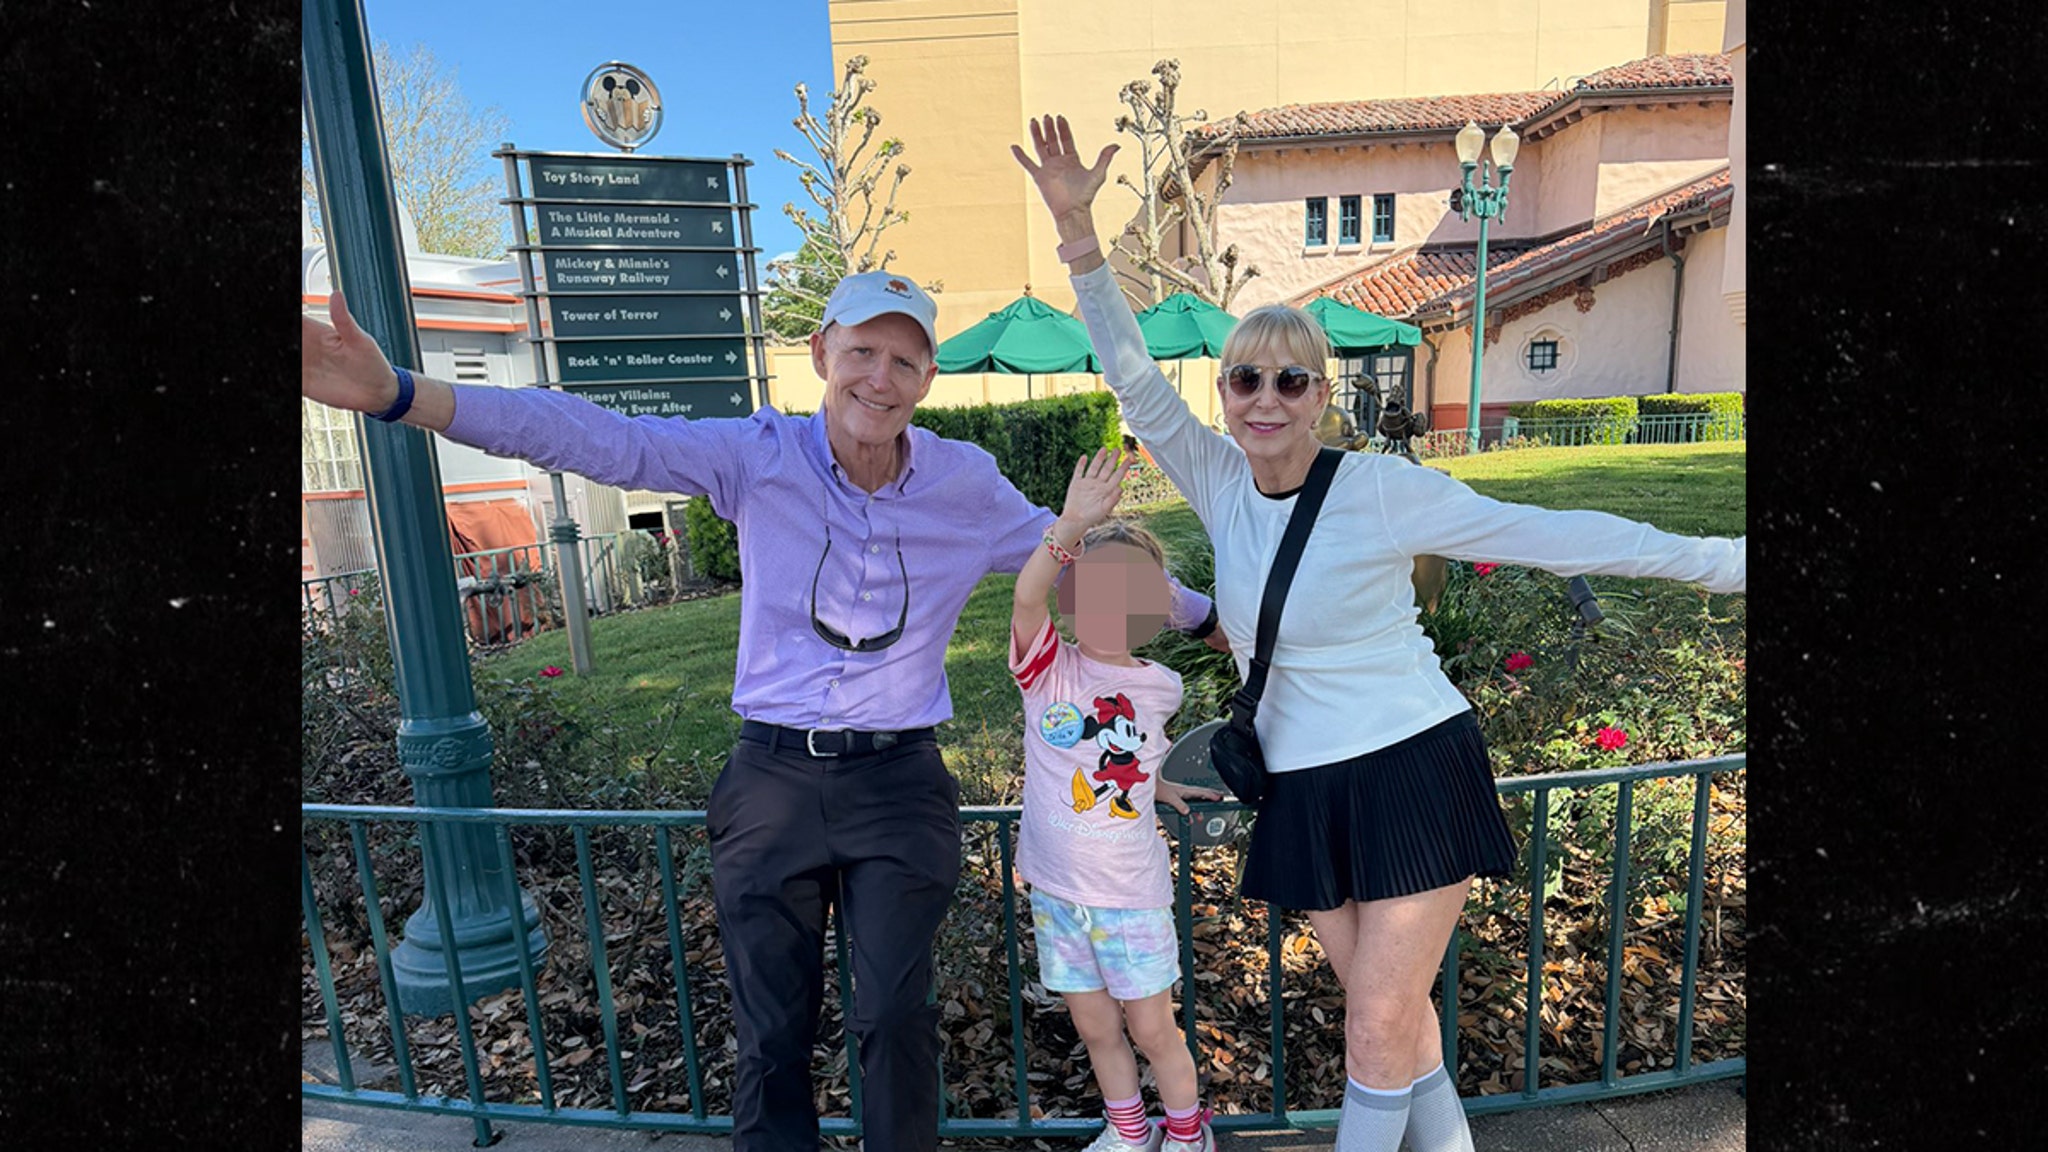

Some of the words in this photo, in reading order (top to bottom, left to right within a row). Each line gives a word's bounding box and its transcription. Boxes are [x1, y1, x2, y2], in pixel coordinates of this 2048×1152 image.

[543, 171, 566, 185] Toy
[570, 172, 604, 187] Story
[608, 173, 640, 185] Land
[548, 211, 573, 223] The
[576, 212, 611, 223] Little
[614, 213, 670, 224] Mermaid
[551, 227, 561, 237] A
[564, 226, 613, 238] Musical
[616, 227, 680, 239] Adventure
[555, 258, 600, 271] Mickey
[604, 258, 615, 269] &
[618, 258, 670, 269] Minnie's
[557, 273, 616, 286] Runaway
[619, 272, 670, 286] Railway
[561, 310, 600, 321] Tower
[603, 309, 617, 320] of
[620, 310, 659, 320] Terror
[568, 356, 599, 367] Rock
[603, 355, 622, 366] 'n'
[626, 354, 664, 365] Roller
[668, 354, 714, 364] Coaster
[619, 389, 671, 401] Villains:
[631, 404, 658, 414] Ever
[661, 402, 692, 413] After
